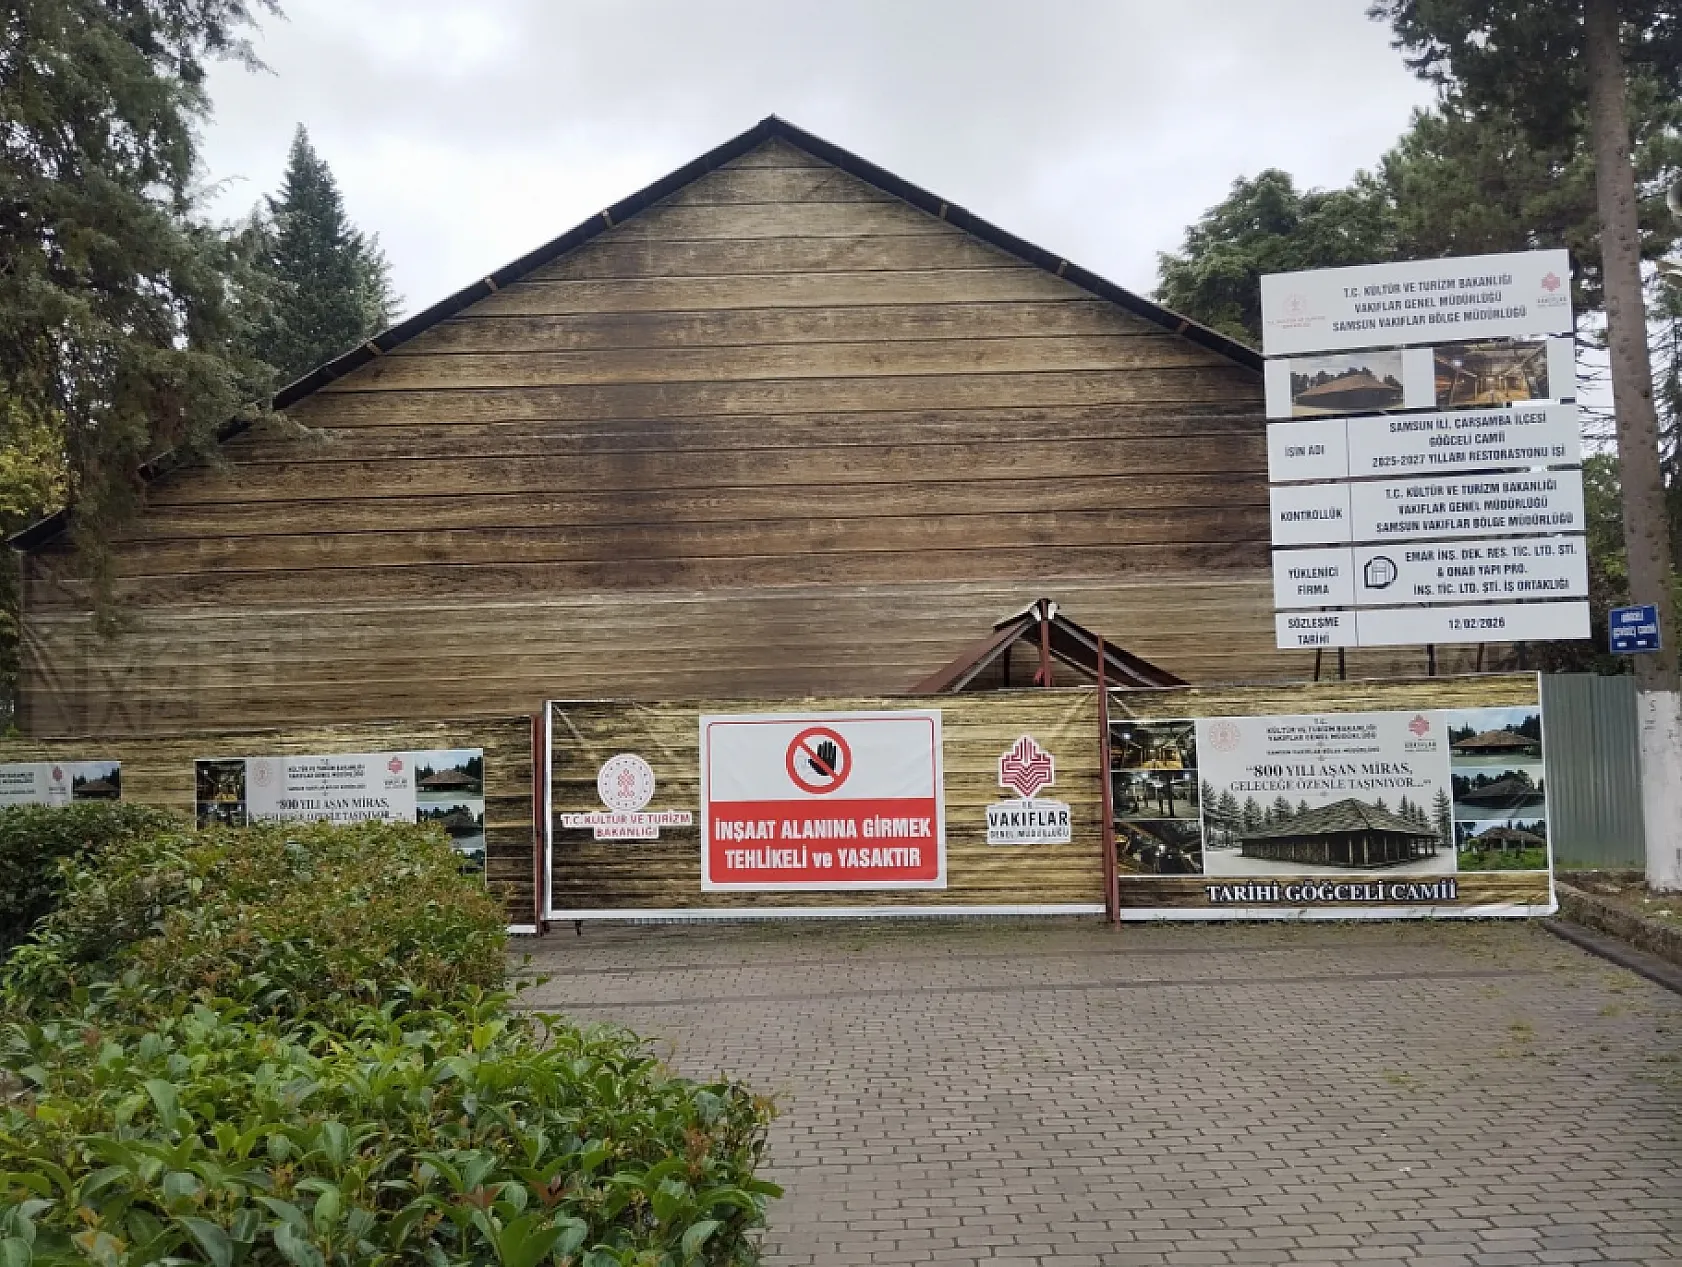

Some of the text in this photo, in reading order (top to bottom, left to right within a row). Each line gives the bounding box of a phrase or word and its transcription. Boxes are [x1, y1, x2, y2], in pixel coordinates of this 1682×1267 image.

[1403, 281, 1416, 293] VE
[1418, 278, 1456, 291] TURİZM
[1354, 299, 1402, 314] VAKIFLAR
[1404, 297, 1436, 309] GENEL
[1332, 318, 1376, 332] SAMSUN
[1378, 314, 1426, 329] VAKIFLAR
[1428, 310, 1461, 324] BÖLGE
[1389, 419, 1433, 433] SAMSUN
[1371, 453, 1425, 468] 2025-2027
[1428, 451, 1466, 465] YILLARI
[1469, 446, 1548, 462] RESTORASYONU
[1406, 483, 1444, 498] KÜLTÜR
[1446, 484, 1459, 496] VE
[1461, 481, 1500, 496] TURİZM
[1502, 478, 1557, 493] BAKANLIĞI
[1280, 506, 1343, 522] KONTROLLÜK
[1398, 501, 1446, 516] VAKIFLAR
[1448, 500, 1480, 513] GENEL
[1376, 520, 1420, 533] SAMSUN
[1422, 517, 1470, 531] VAKIFLAR
[1472, 515, 1505, 529] BÖLGE
[1533, 544, 1555, 556] LTD.
[1478, 563, 1501, 576] YAPI
[1297, 583, 1330, 596] FİRMA
[1459, 581, 1480, 594] LTD.
[1517, 577, 1570, 592] ORTAKLIĞI
[1448, 616, 1506, 630] 12/02/2026
[1297, 632, 1330, 646] TARİHİ
[1231, 777, 1292, 793] GELECEĞE
[630, 813, 643, 824] VE
[647, 811, 691, 824] TURİZM
[988, 810, 1069, 827] VAKIFLAR
[715, 813, 932, 843] İNŞAAT ALANINA GİRMEK
[725, 844, 922, 869] TEHLİKELİ ve YASAKTIR
[1205, 876, 1457, 901] TARİHİ GÖĞCELİ CAMİİ
